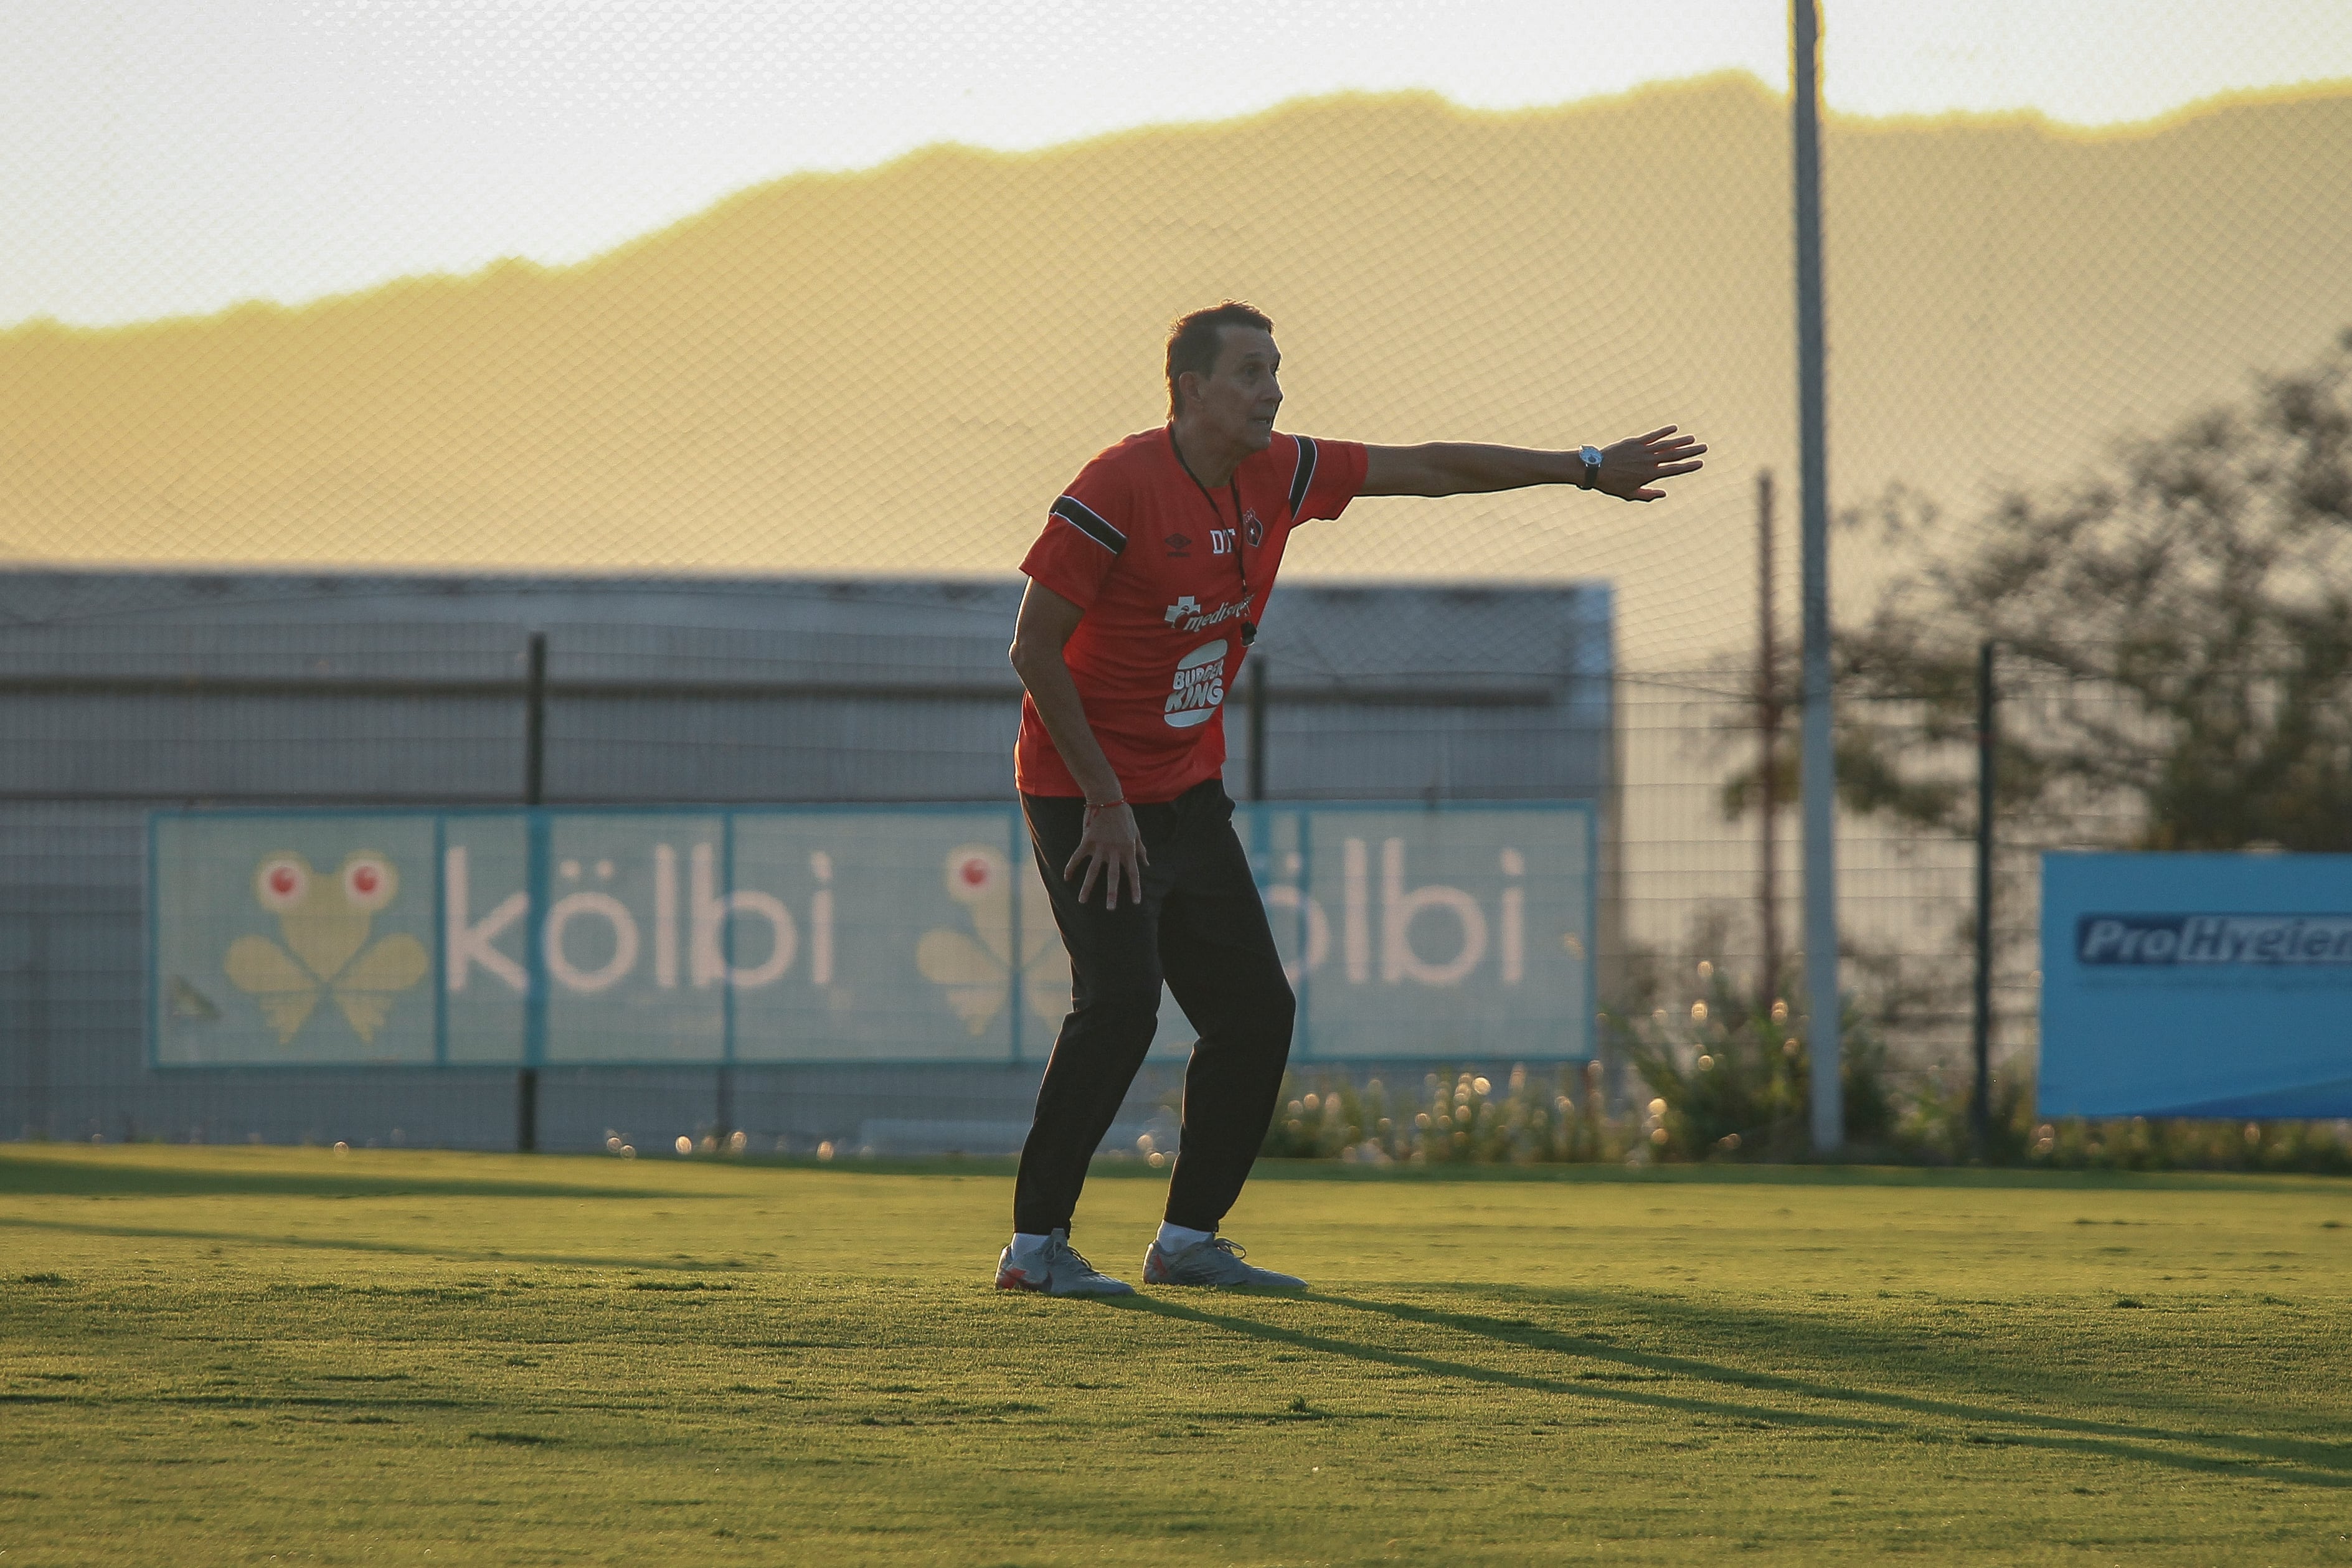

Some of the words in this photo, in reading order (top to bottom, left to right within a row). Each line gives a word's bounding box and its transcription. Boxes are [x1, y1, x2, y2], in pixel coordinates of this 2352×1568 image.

[1164, 678, 1224, 712] KING
[446, 843, 833, 993] kölbi
[1253, 838, 1524, 985] ölbi
